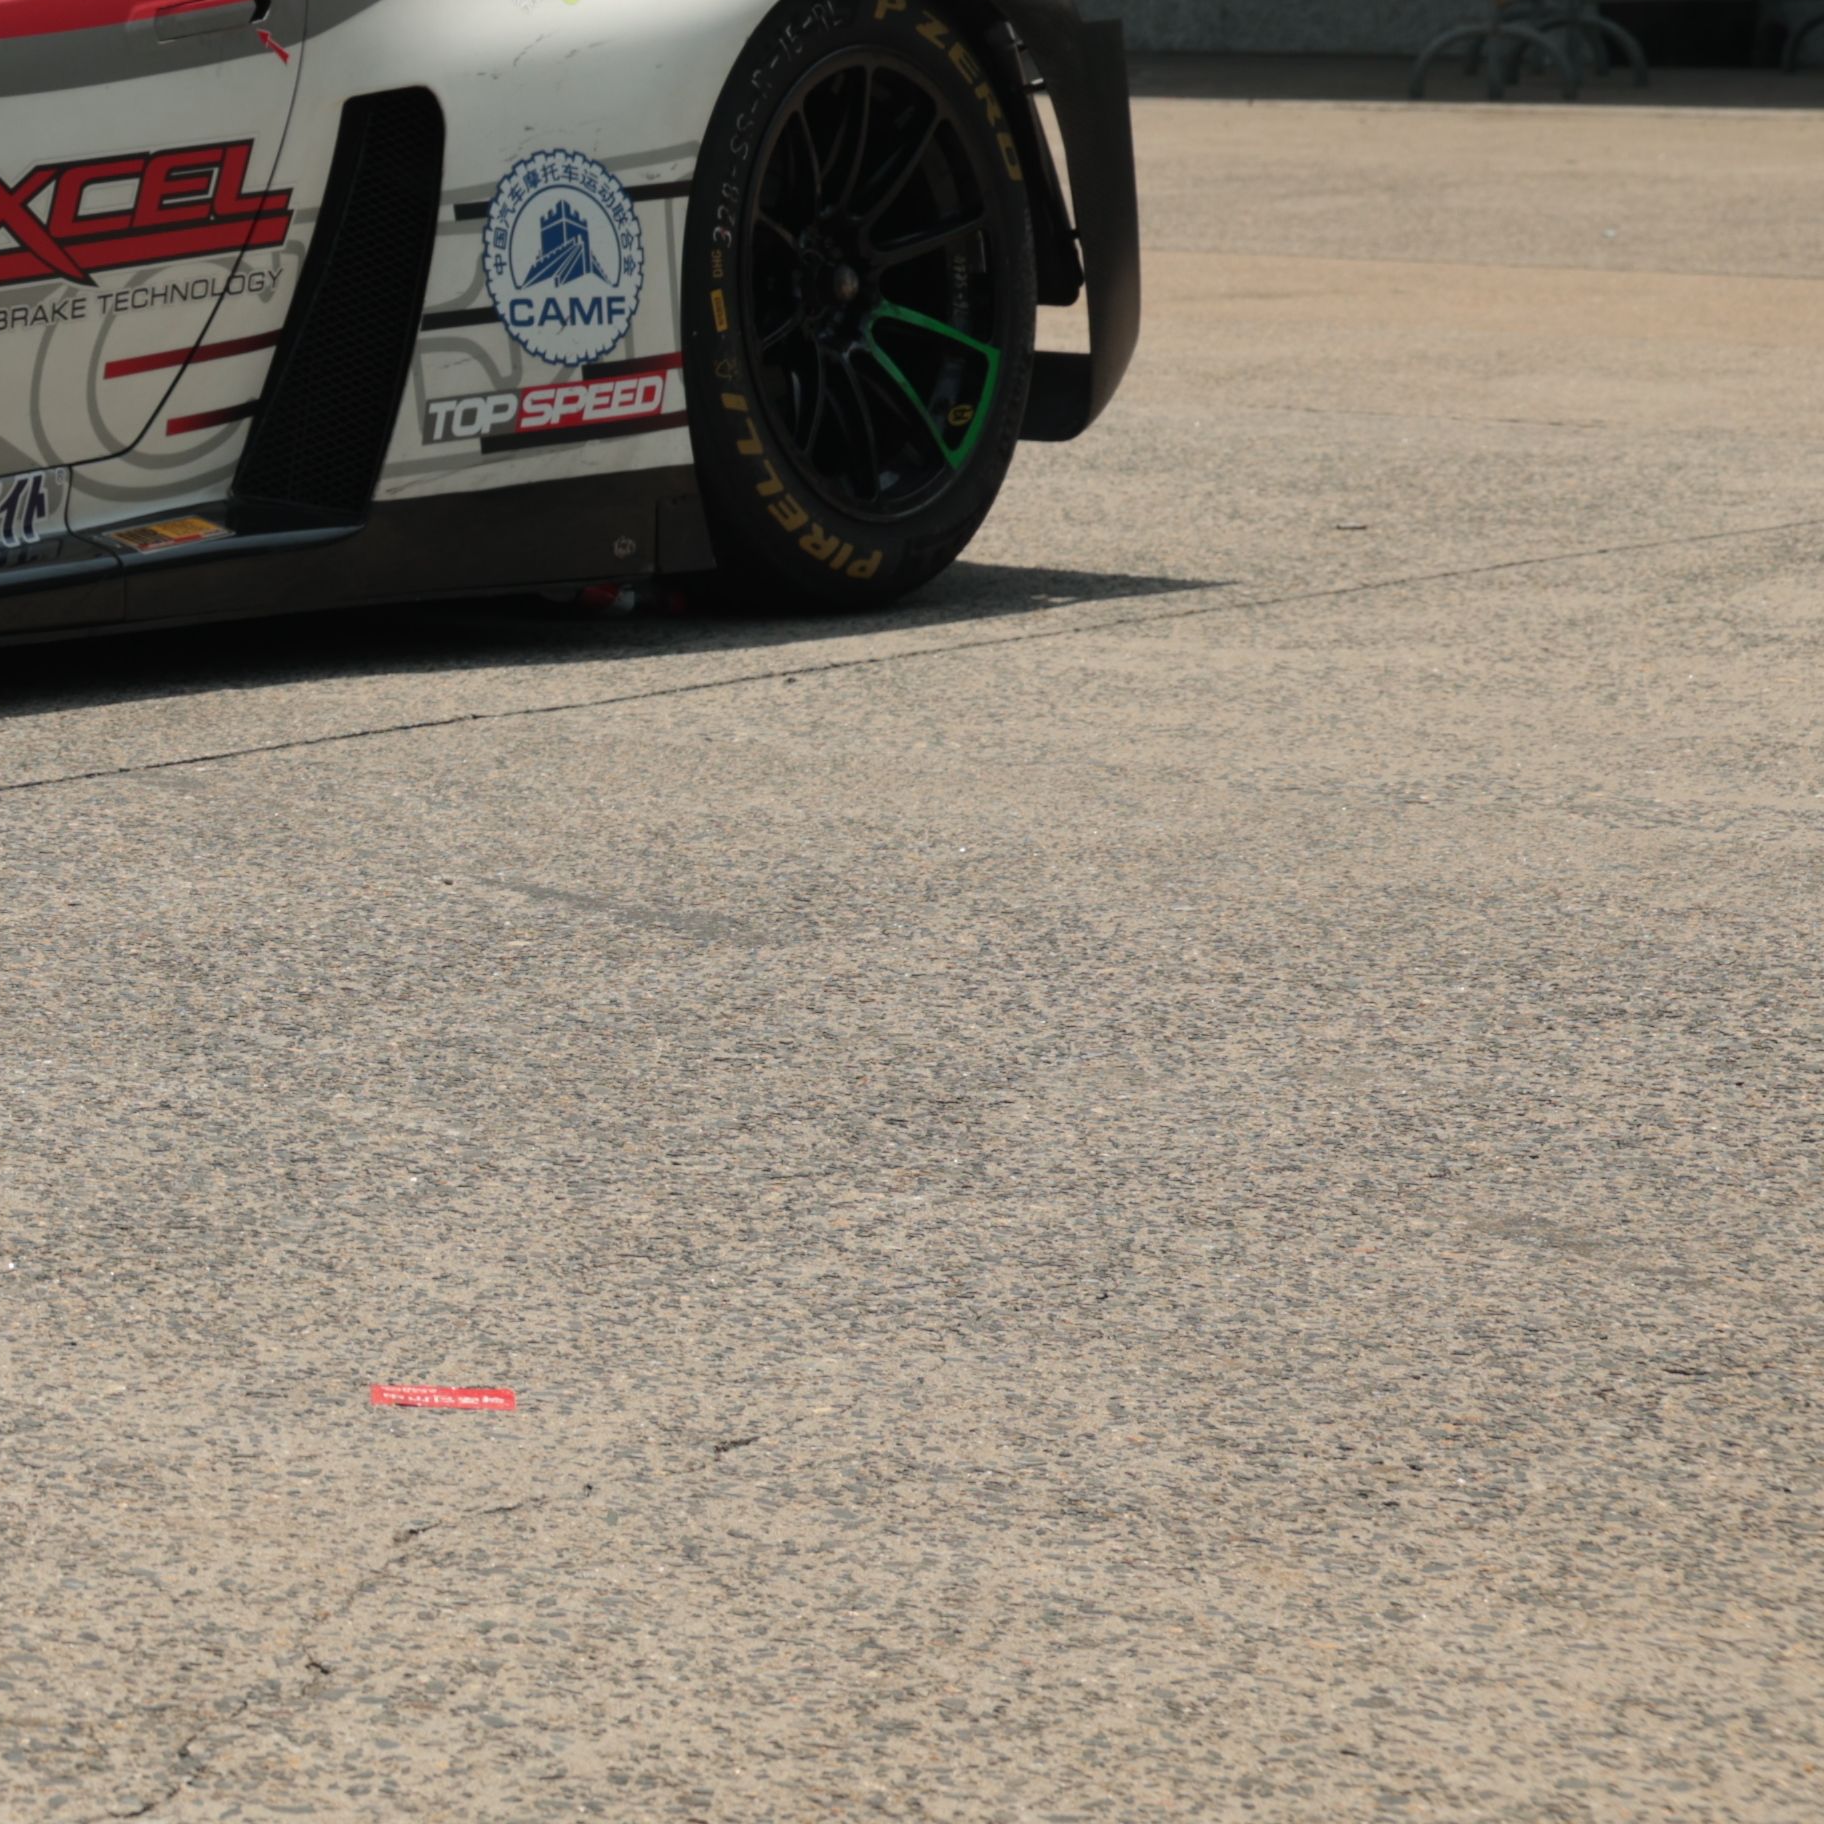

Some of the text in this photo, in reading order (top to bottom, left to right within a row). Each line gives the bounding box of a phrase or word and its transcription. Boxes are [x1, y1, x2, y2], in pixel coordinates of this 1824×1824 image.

[915, 7, 1023, 183] ZERO
[97, 267, 287, 319] TECHNOLOGY
[508, 295, 626, 328] CAMF
[427, 375, 665, 441] TOP SPEED
[720, 391, 885, 581] PIRELLI
